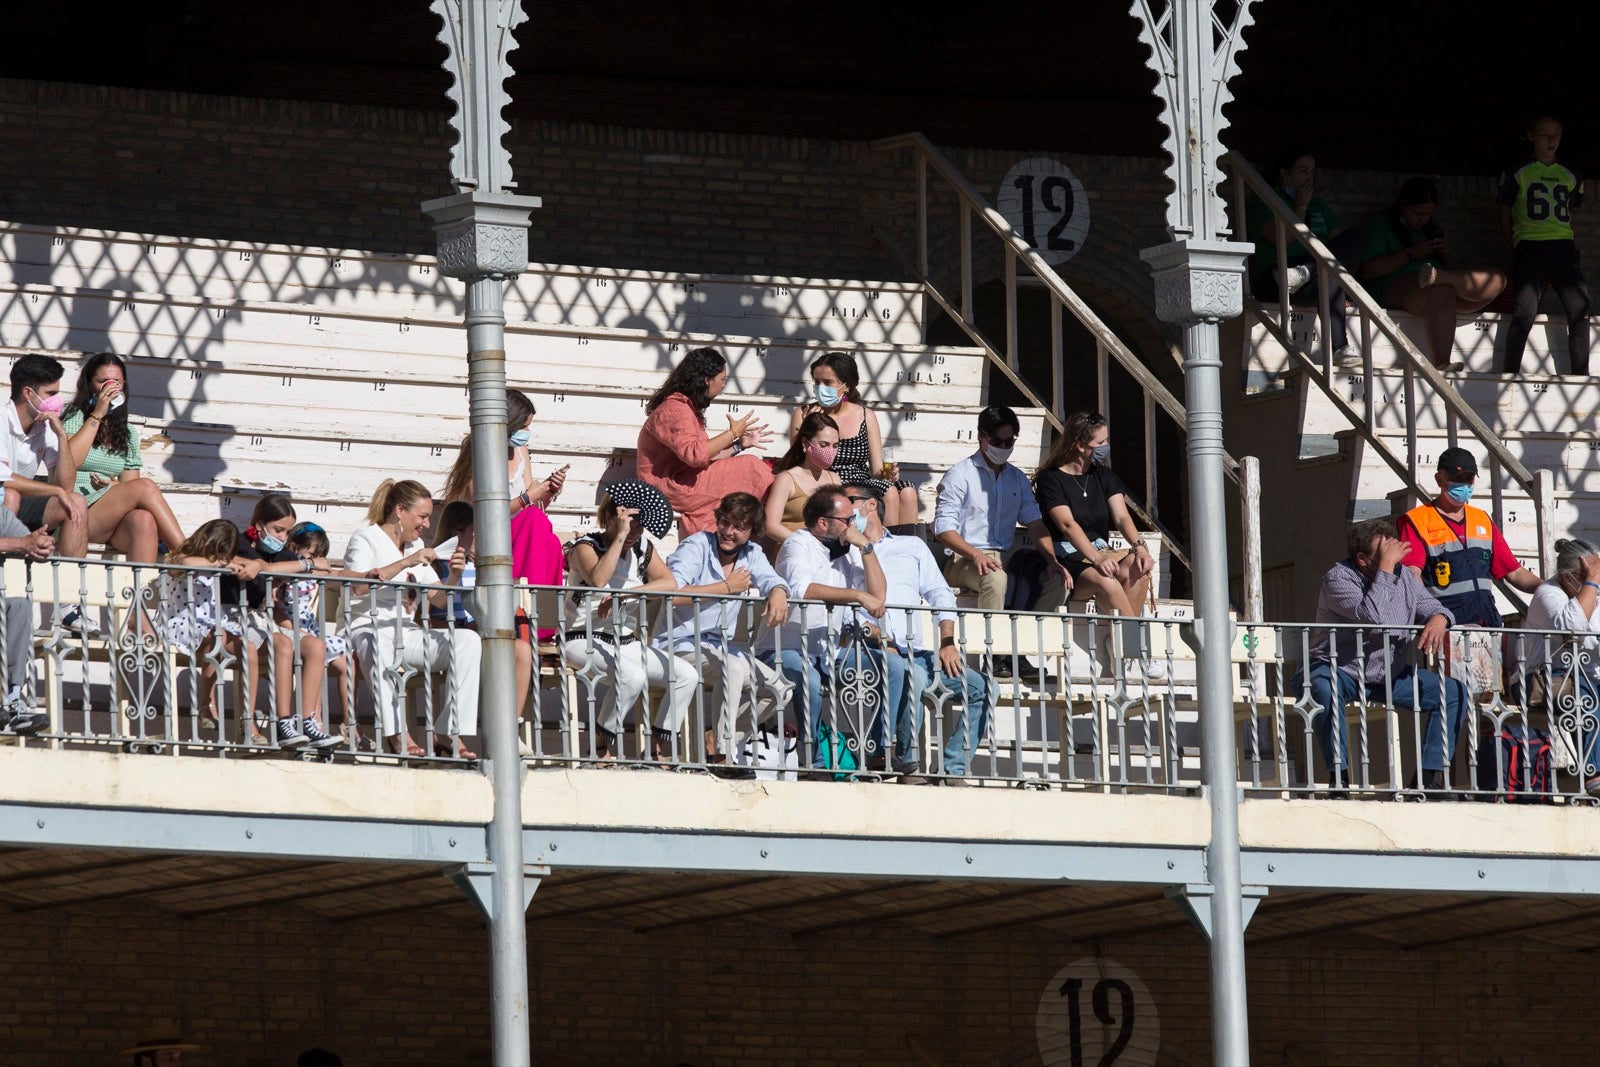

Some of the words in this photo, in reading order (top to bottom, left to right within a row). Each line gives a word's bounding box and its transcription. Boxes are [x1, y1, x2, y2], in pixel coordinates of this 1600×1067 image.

[1527, 182, 1571, 223] 68
[1014, 175, 1075, 250] 12
[52, 236, 64, 246] 10
[146, 245, 157, 254] 11
[239, 251, 251, 262] 12
[419, 264, 431, 275] 14
[596, 277, 607, 288] 16
[776, 286, 788, 296] 18
[868, 290, 880, 300] 19
[31, 294, 39, 303] 9
[124, 302, 136, 312] 10
[217, 308, 227, 318] 11
[831, 307, 869, 318] FILA
[882, 308, 891, 320] 6
[1291, 313, 1304, 322] 20
[308, 315, 320, 325] 12
[578, 336, 589, 345] 15
[668, 342, 679, 351] 16
[933, 355, 945, 365] 19
[190, 370, 202, 380] 10
[896, 371, 932, 382] FILA
[943, 374, 951, 384] 5
[282, 376, 292, 387] 11
[1348, 376, 1362, 385] 20
[374, 381, 386, 391] 12
[553, 393, 565, 402] 14
[728, 403, 739, 413] 16
[904, 412, 917, 422] 18
[250, 436, 263, 446] 10
[340, 441, 351, 451] 11
[430, 446, 442, 456] 12
[315, 503, 327, 513] 10
[1111, 539, 1122, 549] 19
[1059, 978, 1135, 1067] 12
